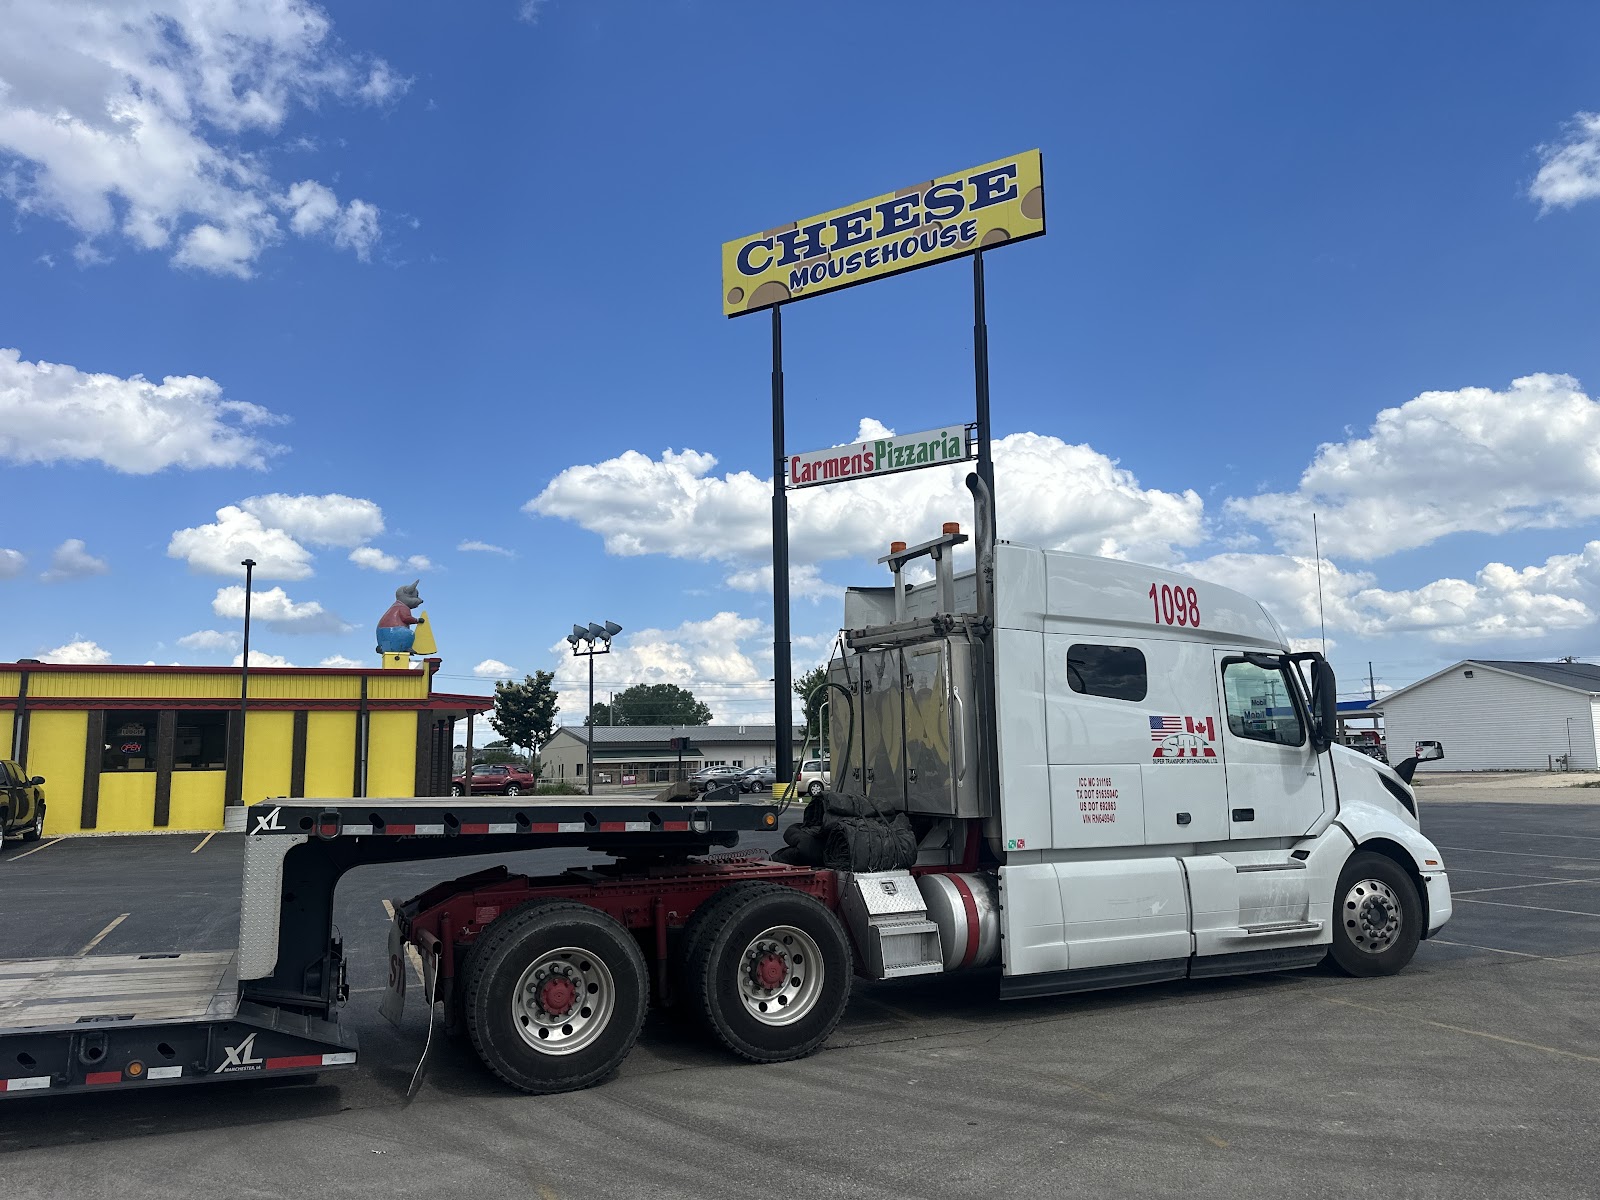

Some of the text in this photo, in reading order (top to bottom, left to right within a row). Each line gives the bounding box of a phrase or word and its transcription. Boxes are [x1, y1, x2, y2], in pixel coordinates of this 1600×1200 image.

[736, 163, 1018, 276] CHEESE
[789, 219, 978, 291] MOUSEHOUSE
[791, 431, 961, 484] Carmen's Pizzaria
[1149, 583, 1200, 627] 1098
[1244, 710, 1265, 719] Mobil
[1076, 789, 1083, 799] TX
[1084, 789, 1095, 799] DOT
[1078, 777, 1087, 787] ICC
[250, 806, 287, 835] XL
[1080, 801, 1088, 811] US
[1088, 801, 1099, 811] DOT
[1082, 813, 1092, 824] VIN
[213, 1032, 264, 1073] XL
